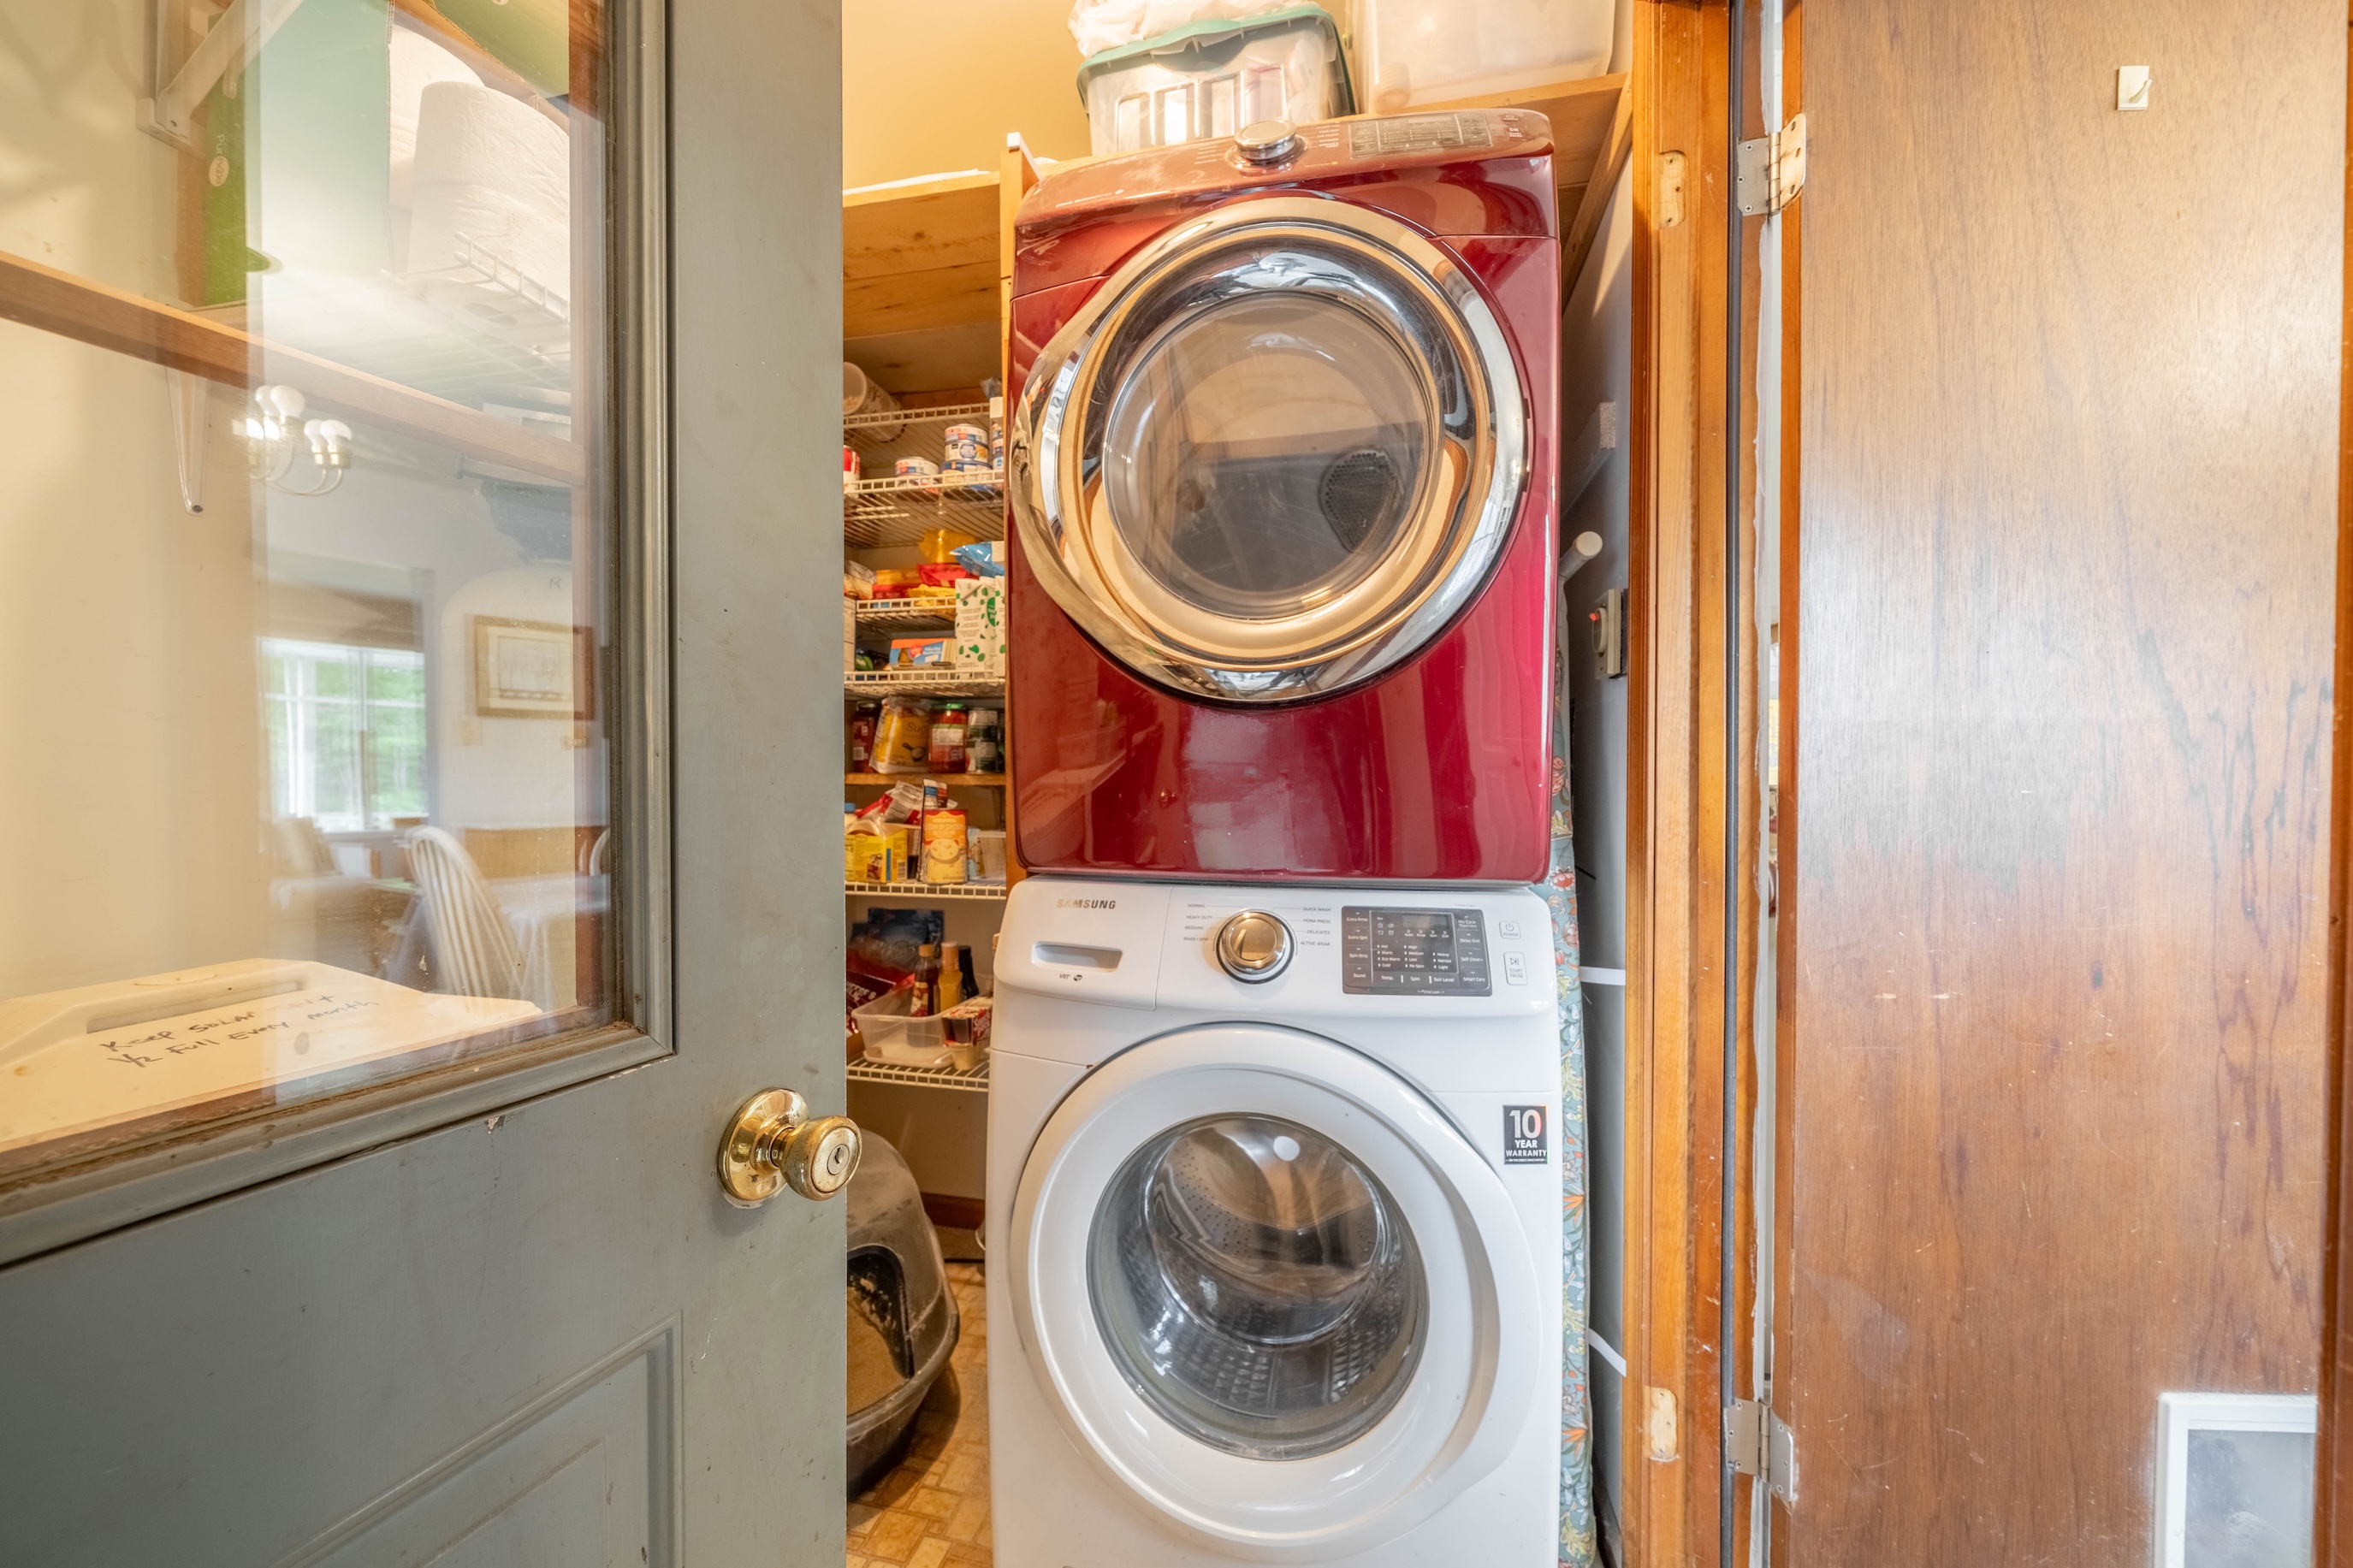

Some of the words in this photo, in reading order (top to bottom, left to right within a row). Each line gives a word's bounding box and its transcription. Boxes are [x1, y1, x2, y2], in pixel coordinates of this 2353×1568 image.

[1056, 898, 1117, 910] SAMSUNG
[1509, 1109, 1542, 1139] 10
[1514, 1139, 1538, 1148] YEAR
